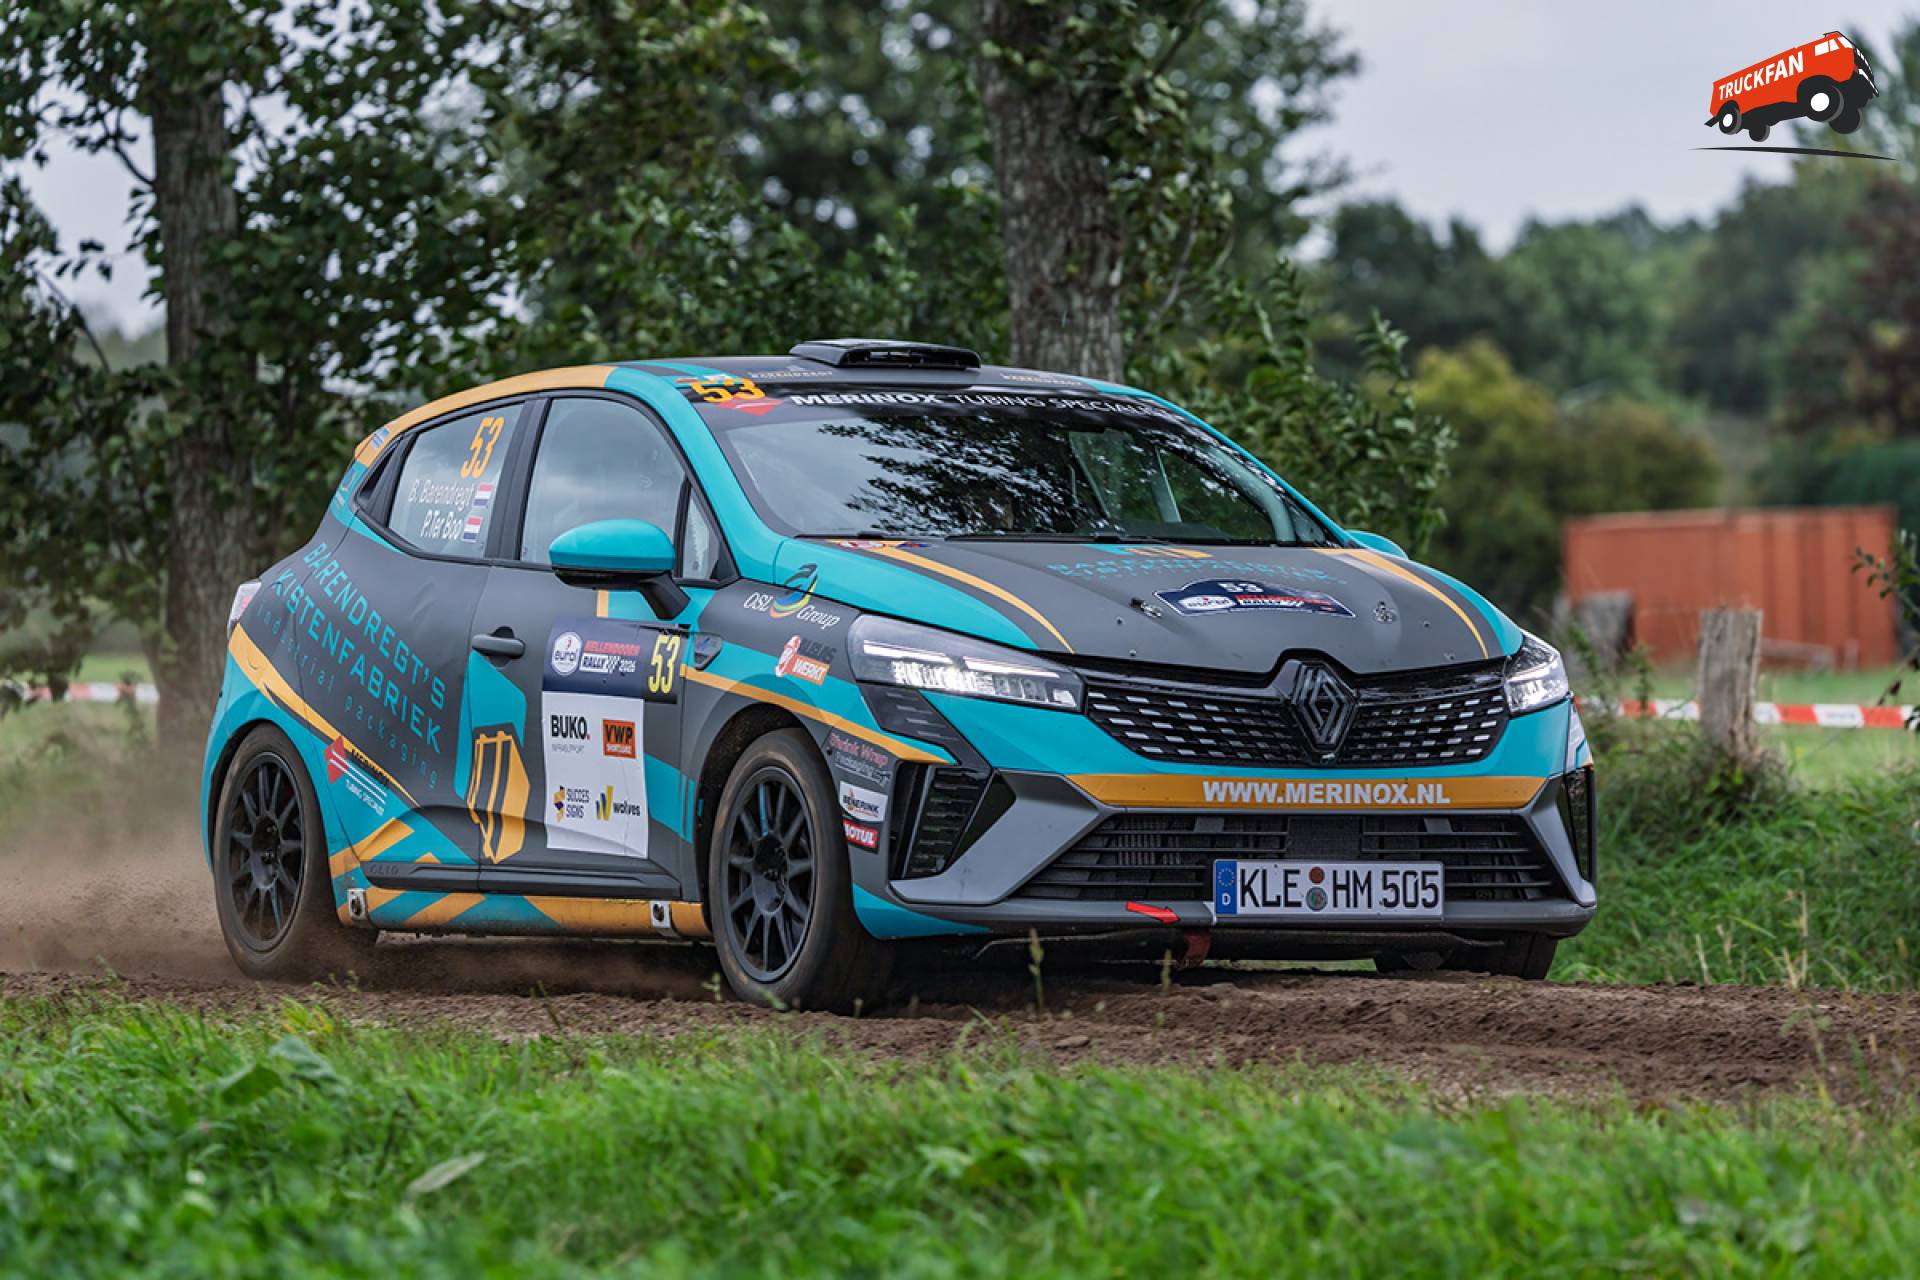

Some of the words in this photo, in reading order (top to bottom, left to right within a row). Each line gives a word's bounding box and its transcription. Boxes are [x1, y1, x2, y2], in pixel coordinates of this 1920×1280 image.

[690, 377, 766, 403] 53
[789, 392, 944, 406] MERINOX
[949, 394, 1046, 409] TUBING
[460, 415, 505, 479] 53
[1218, 581, 1264, 593] 53
[303, 542, 447, 711] BARENDREGT'S
[796, 604, 841, 630] Group
[271, 567, 441, 753] KISTENFABRIEK
[648, 634, 681, 694] 53
[604, 723, 633, 744] VWP
[1202, 781, 1451, 804] WWW.MERINOX.NL
[613, 801, 641, 817] wolves
[844, 822, 876, 847] MOTUL
[1222, 892, 1231, 905] D
[1240, 868, 1304, 908] KLE
[1332, 869, 1373, 909] HM
[1382, 869, 1440, 909] 505
